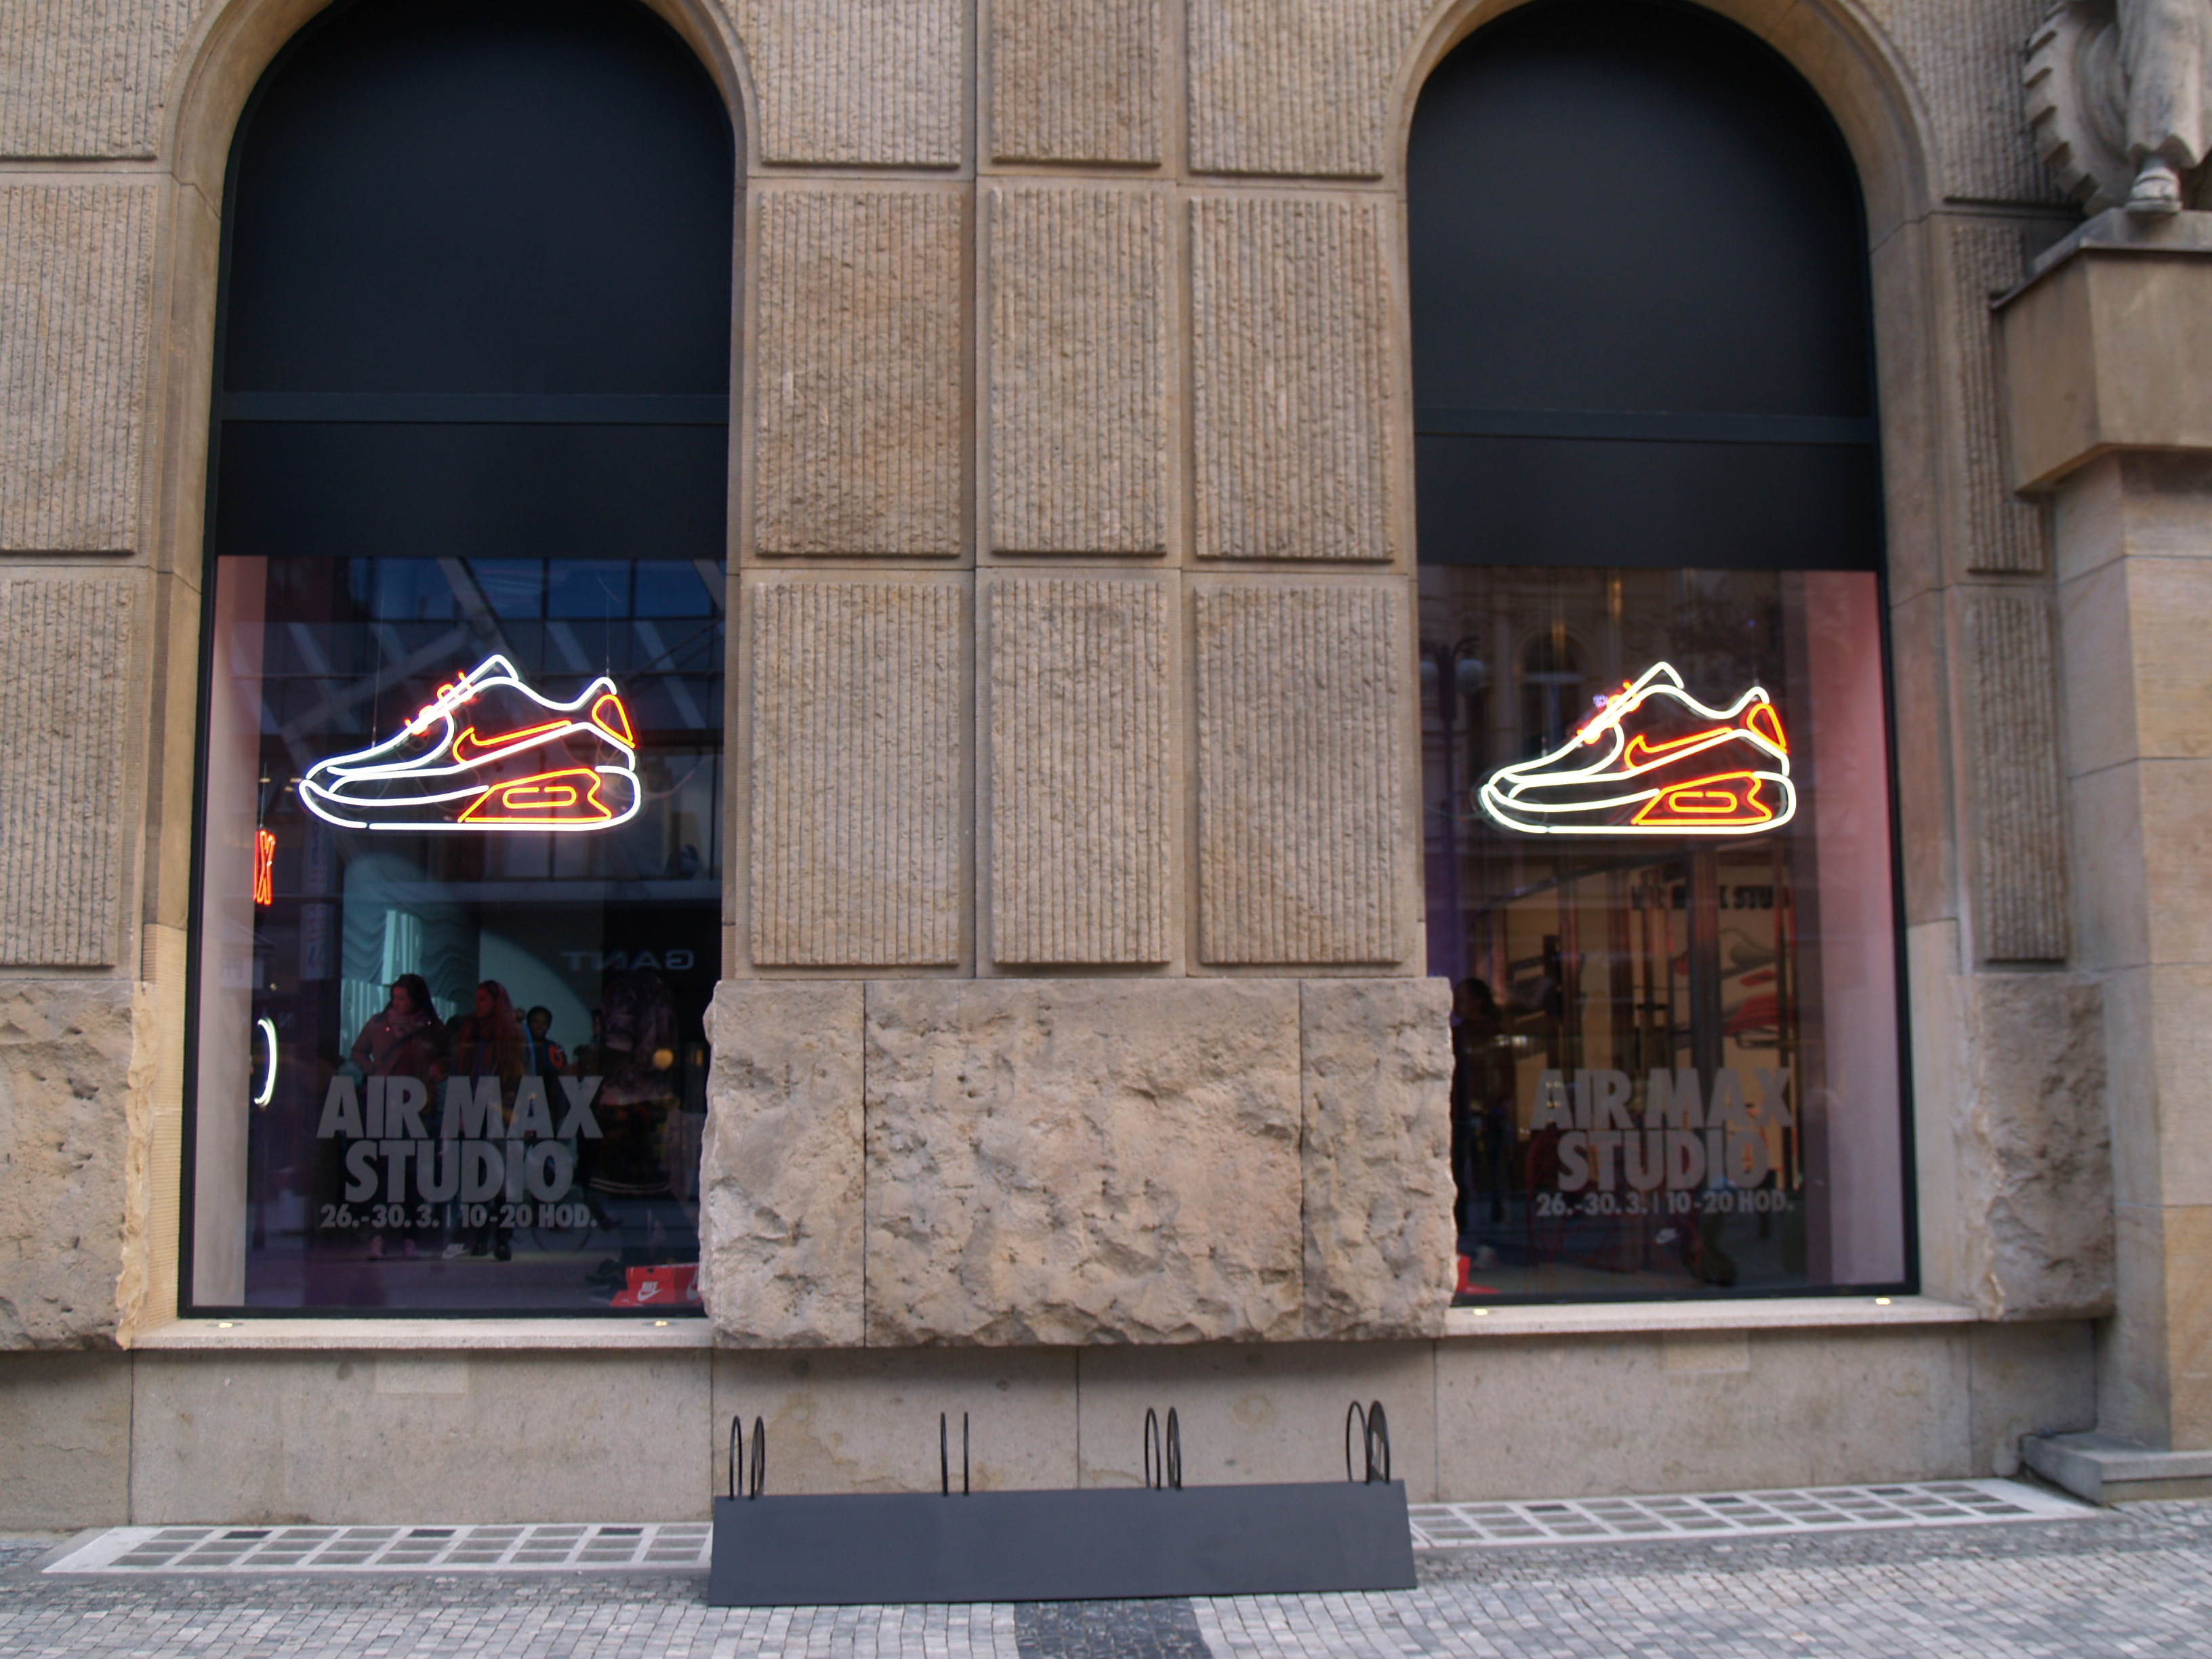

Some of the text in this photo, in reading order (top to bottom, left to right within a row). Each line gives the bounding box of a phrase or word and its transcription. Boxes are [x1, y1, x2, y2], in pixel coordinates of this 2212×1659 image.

[316, 1076, 604, 1139] AIR MAX
[1530, 1067, 1793, 1129] AIR MAX
[345, 1140, 574, 1204] STUDIO
[1557, 1130, 1769, 1191] STUDIO
[538, 1204, 597, 1228] HOD.
[1738, 1190, 1795, 1213] HOD.
